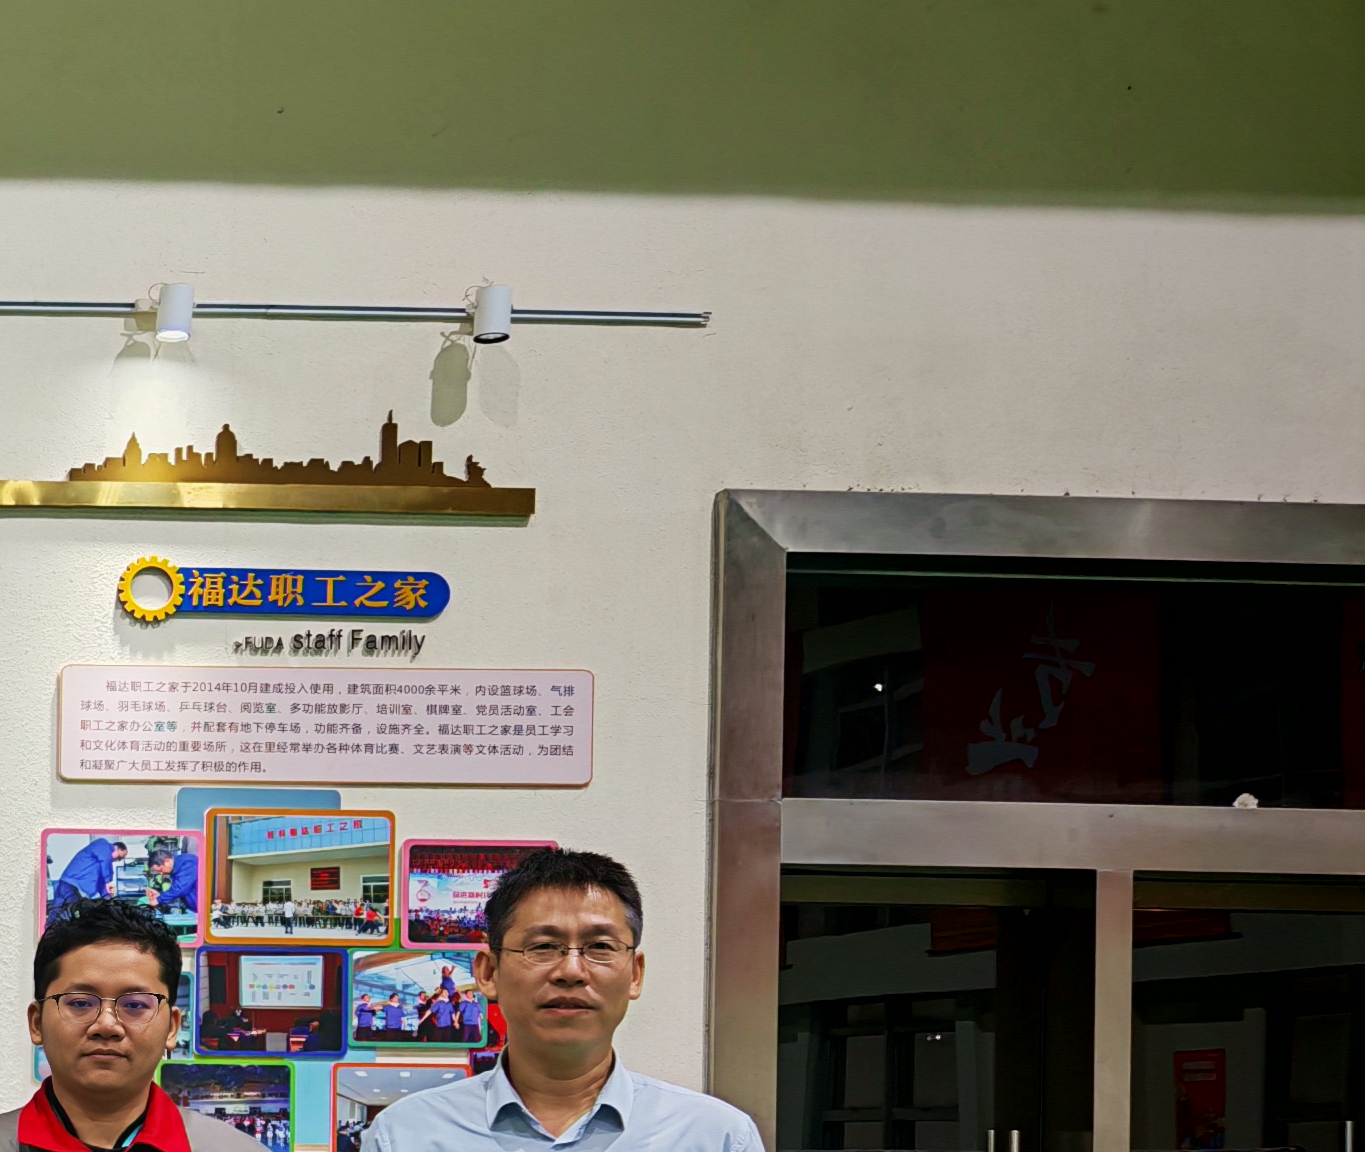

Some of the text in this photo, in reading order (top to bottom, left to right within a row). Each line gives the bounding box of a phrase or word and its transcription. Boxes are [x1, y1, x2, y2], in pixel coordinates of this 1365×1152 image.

[187, 570, 431, 612] 福达职工之家
[244, 629, 427, 656] FUDA staff Family
